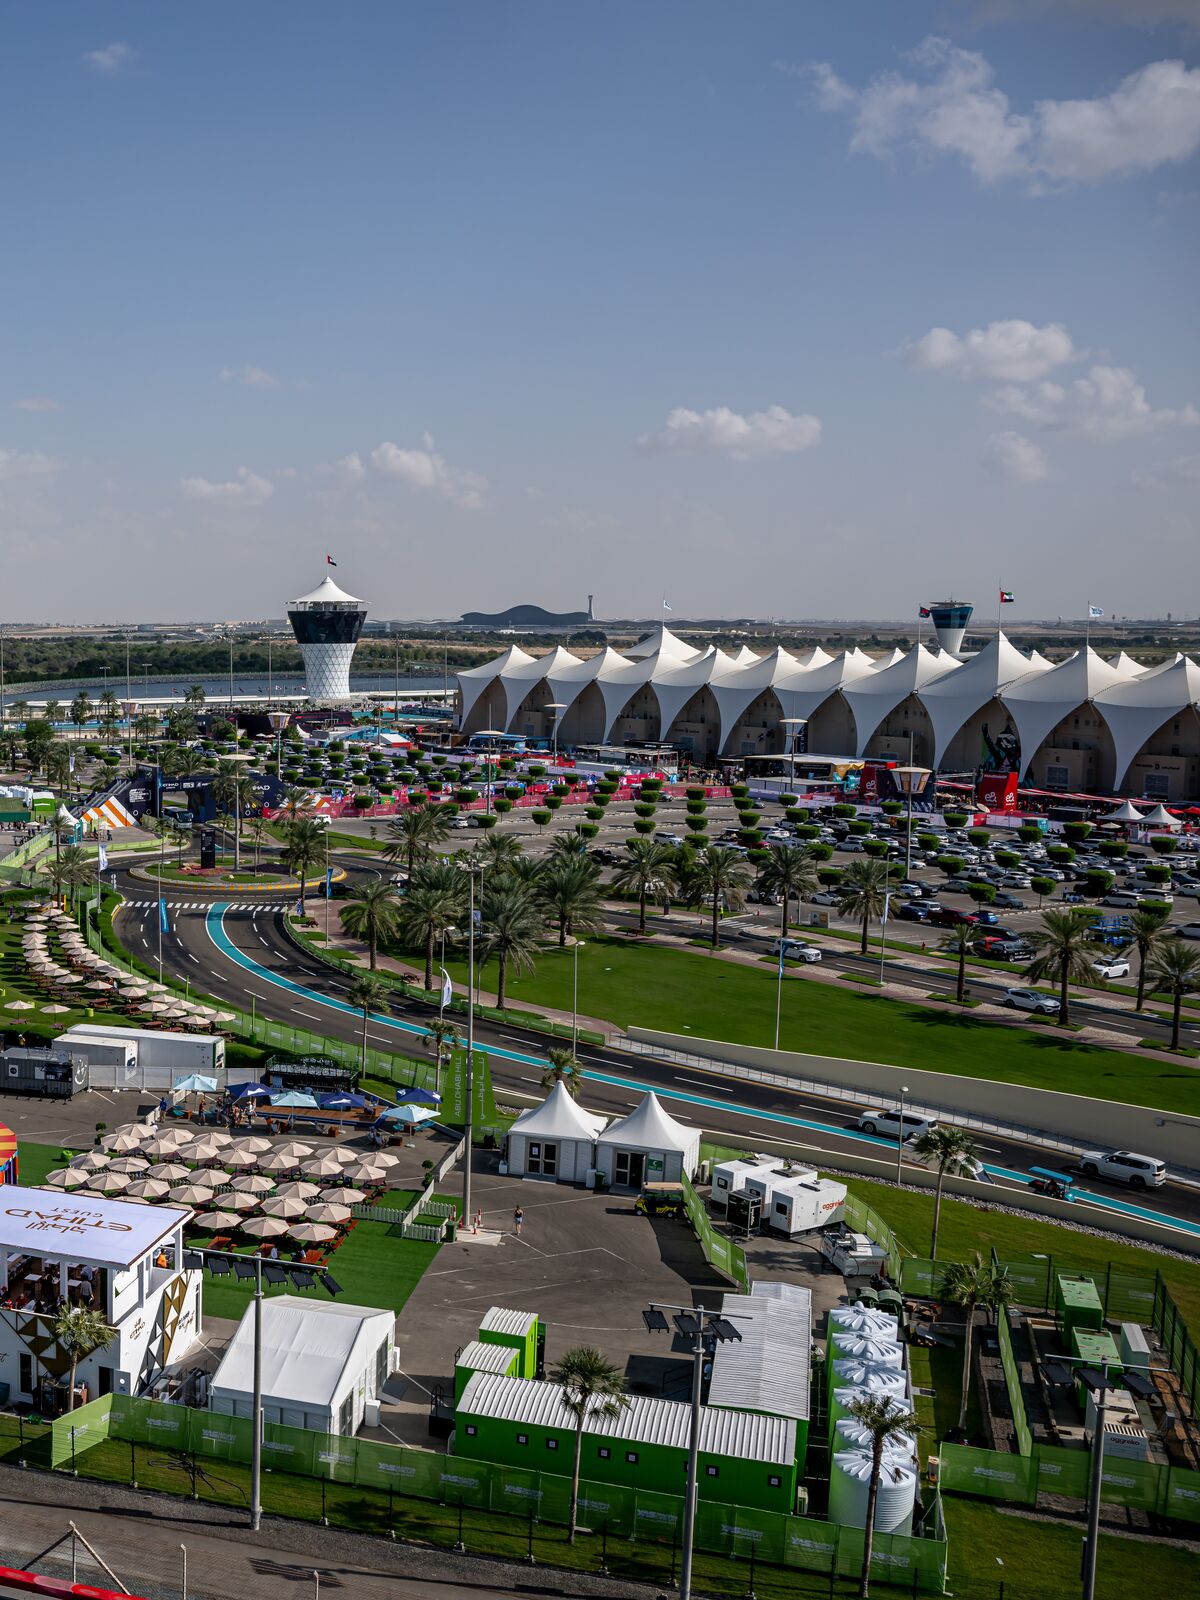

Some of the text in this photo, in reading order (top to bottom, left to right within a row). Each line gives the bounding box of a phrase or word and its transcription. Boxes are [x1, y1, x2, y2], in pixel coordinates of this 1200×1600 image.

[50, 1207, 104, 1219] GUEST
[4, 1208, 133, 1233] ETIHAD
[1110, 1436, 1140, 1447] aggreko
